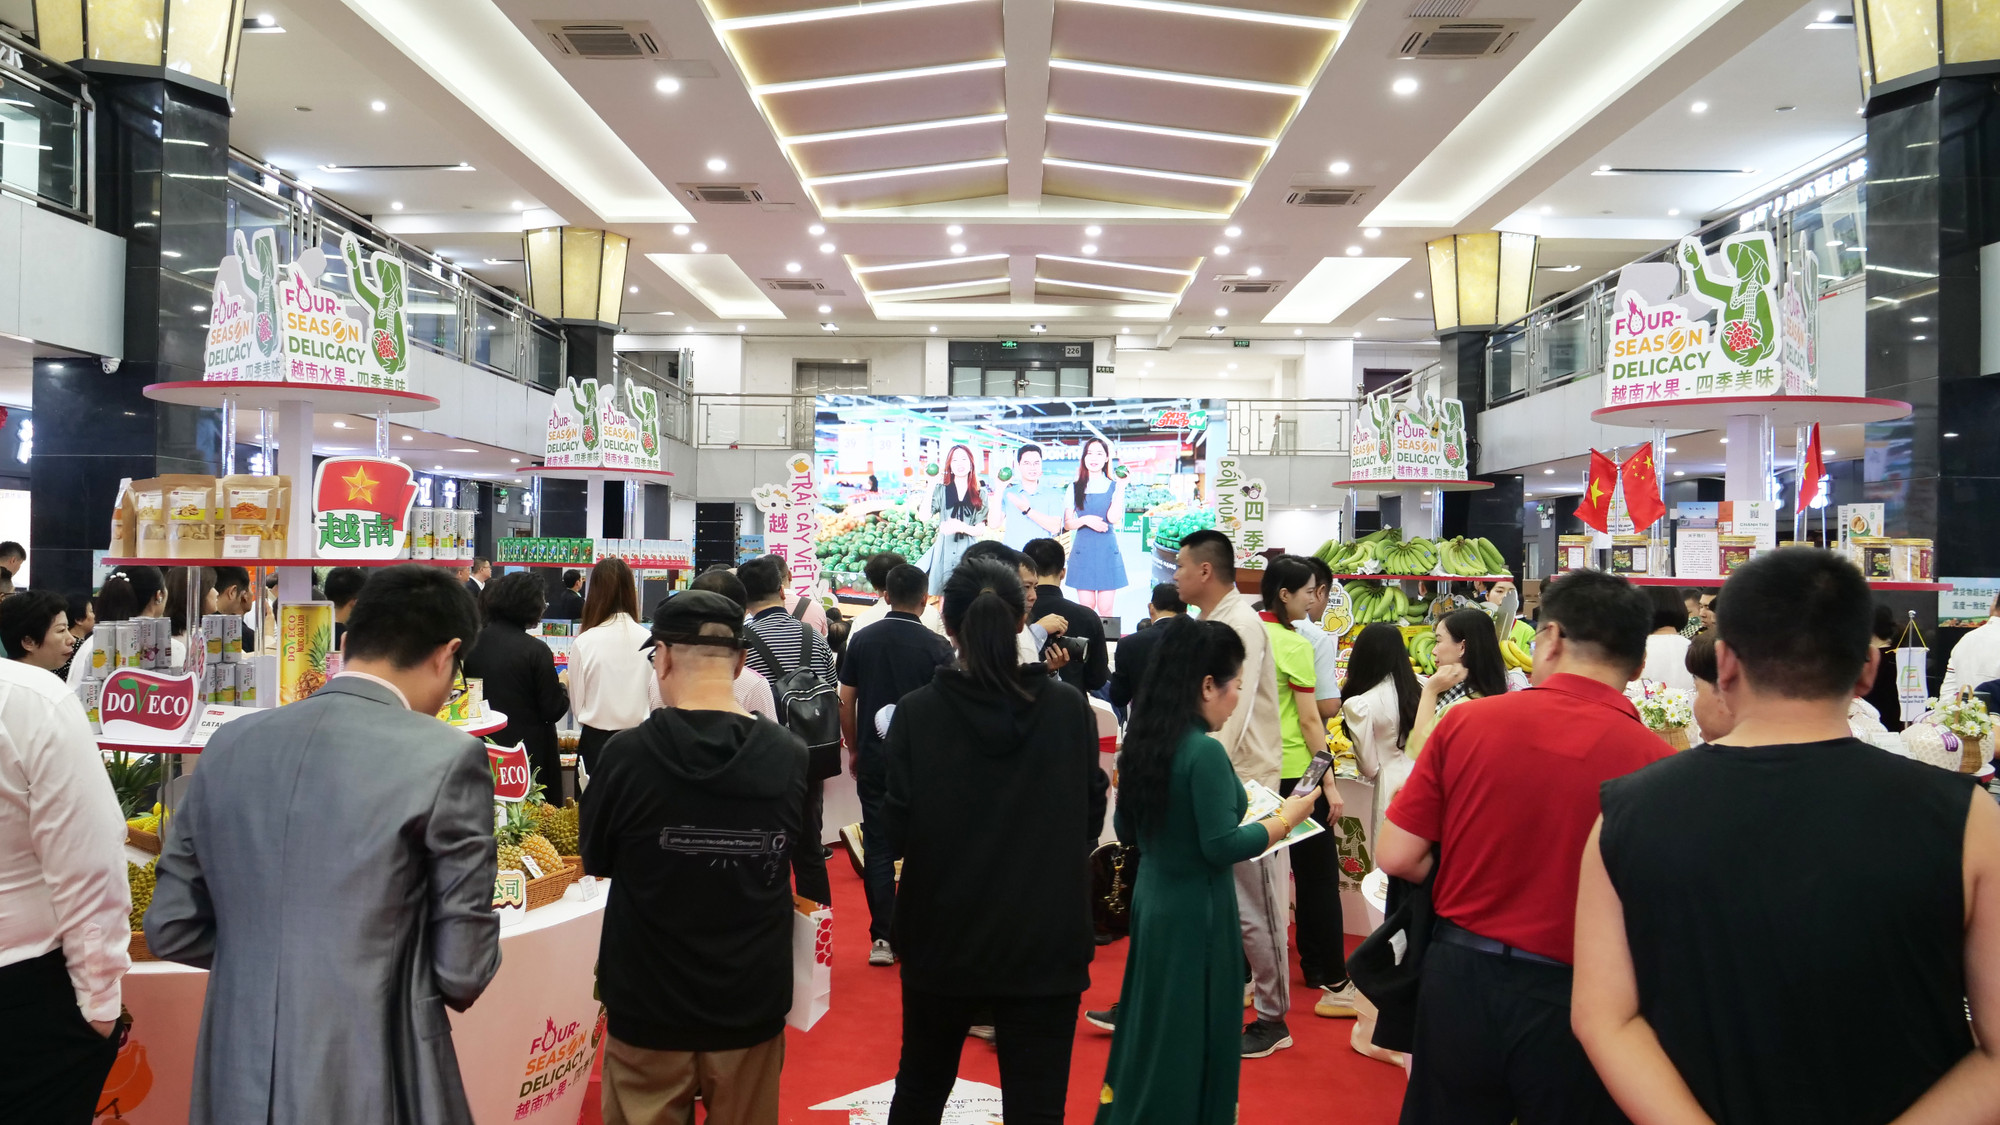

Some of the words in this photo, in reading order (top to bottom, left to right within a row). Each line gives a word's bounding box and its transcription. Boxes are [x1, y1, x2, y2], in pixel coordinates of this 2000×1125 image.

[213, 293, 241, 325] FOUR-
[285, 279, 341, 316] FOUR-
[211, 318, 249, 345] SEASON
[288, 312, 359, 344] SEASON
[1616, 303, 1681, 336] FOUR-
[208, 341, 252, 367] DELICACY
[288, 335, 366, 365] DELICACY
[1614, 326, 1702, 357] SEASON
[291, 359, 346, 385] 越南水果
[1612, 351, 1711, 380] DELICACY
[1611, 378, 1680, 404] 越南水果
[1696, 367, 1774, 395] 四季美味
[549, 411, 570, 429] FOUR-
[603, 407, 627, 426] FOUR-
[1397, 420, 1427, 438] FOUR-
[547, 440, 580, 453] DELICACY
[548, 427, 577, 442] SEASON
[604, 426, 636, 442] SEASON
[604, 439, 639, 453] DELICACY
[1397, 439, 1437, 454] SEASON
[1397, 452, 1440, 465] DELICACY
[318, 512, 395, 550] 越南
[793, 512, 818, 544] CÂY
[106, 681, 189, 716] DOVECO
[530, 1018, 580, 1054] FOUR-
[525, 1030, 587, 1076] SEASON
[519, 1047, 587, 1098] DELICACY
[514, 1079, 567, 1121] 越南水果
